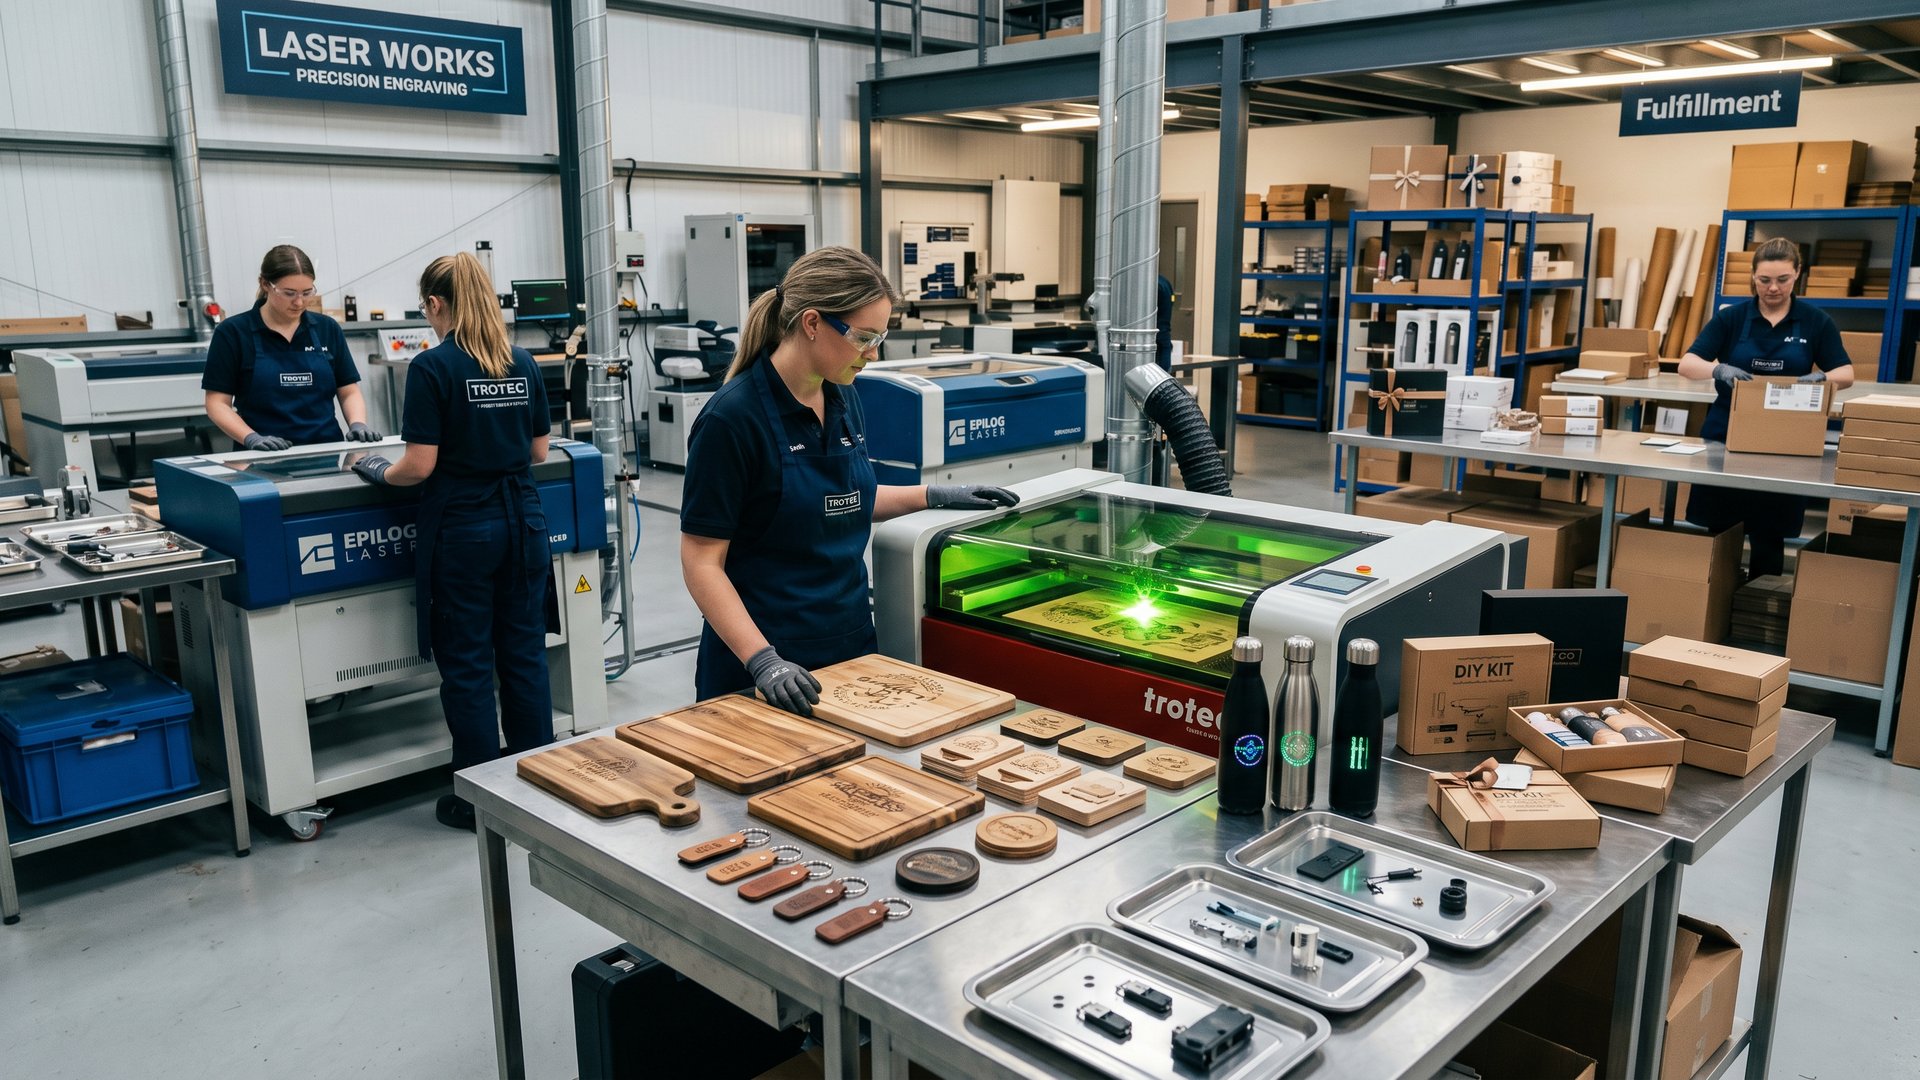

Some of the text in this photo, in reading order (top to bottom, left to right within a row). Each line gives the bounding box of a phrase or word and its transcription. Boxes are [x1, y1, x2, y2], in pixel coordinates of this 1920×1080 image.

[258, 28, 496, 78] LASER WORKS
[296, 67, 468, 97] PRECISION ENGRAVING
[1636, 89, 1782, 121] Fulfillment
[471, 383, 525, 395] TROTEC
[970, 416, 1005, 430] EPILOG
[344, 524, 416, 549] EPILOG
[1455, 662, 1514, 678] DIY KIT
